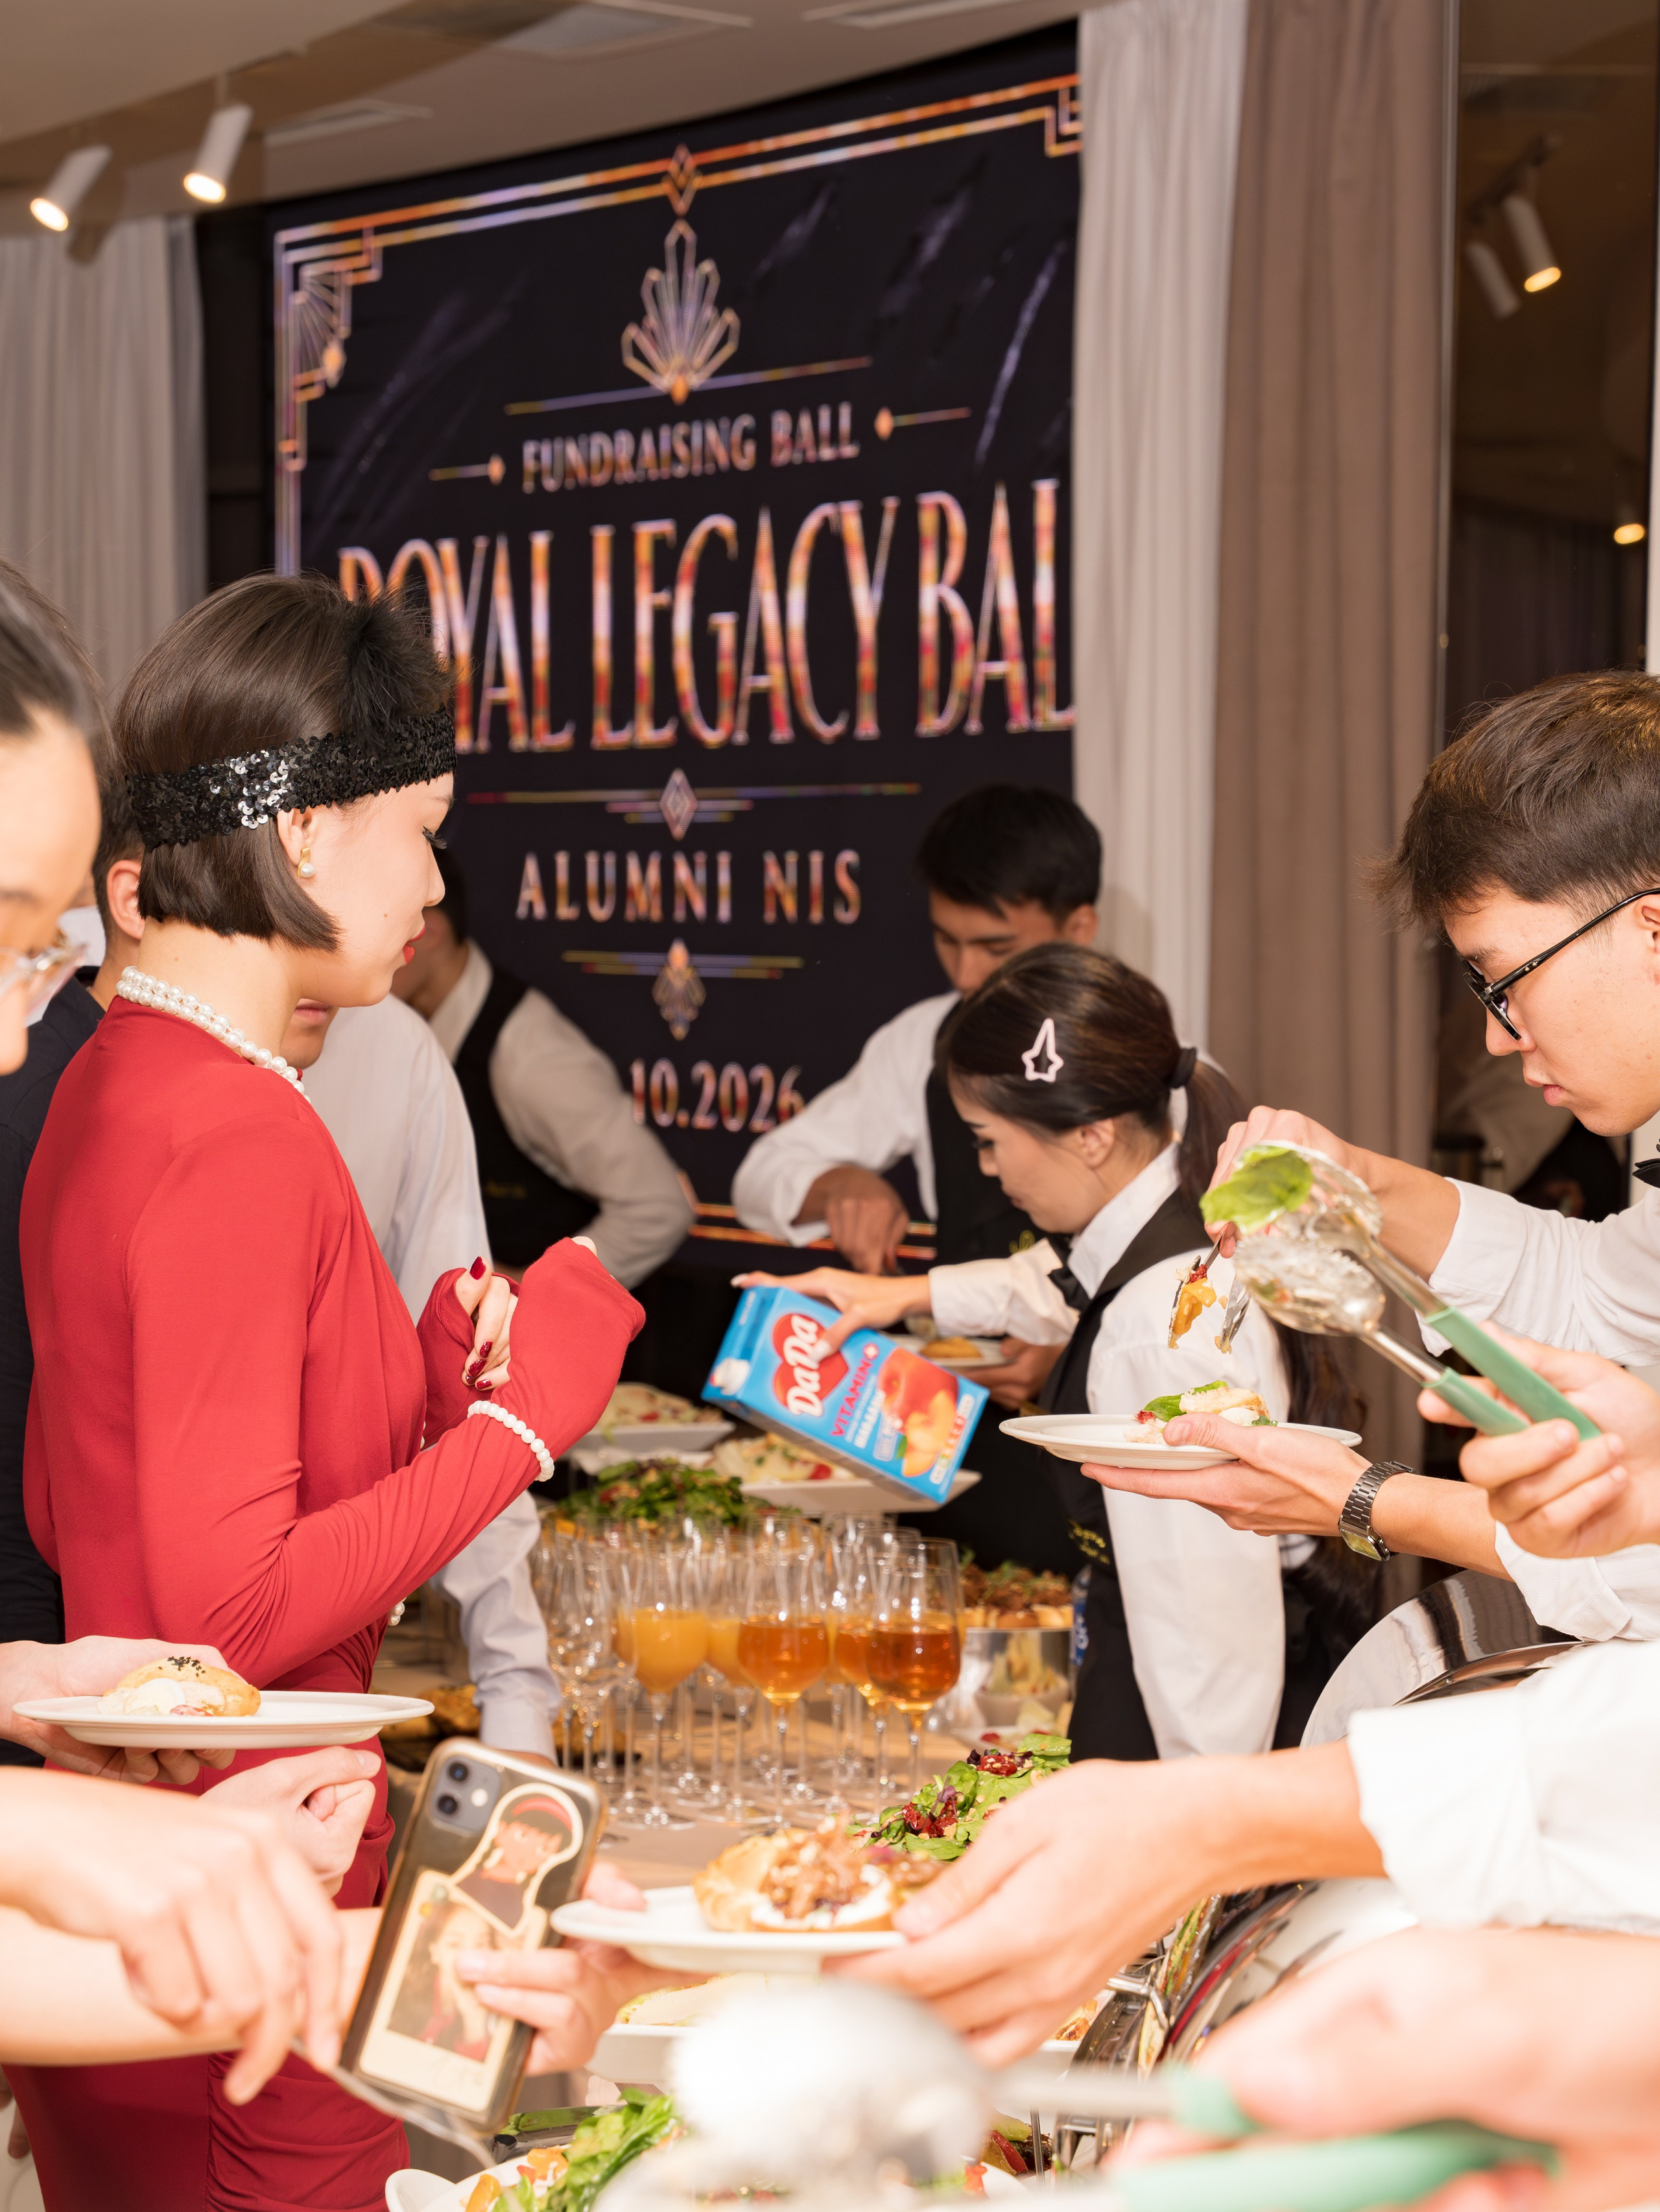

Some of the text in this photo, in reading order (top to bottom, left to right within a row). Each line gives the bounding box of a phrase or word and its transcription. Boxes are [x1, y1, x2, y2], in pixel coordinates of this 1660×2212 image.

[523, 401, 861, 494] FUNDRAISING BALL
[590, 495, 901, 750] LEGACY
[516, 848, 862, 925] ALUMNI NIS
[783, 1314, 824, 1417] DaDa
